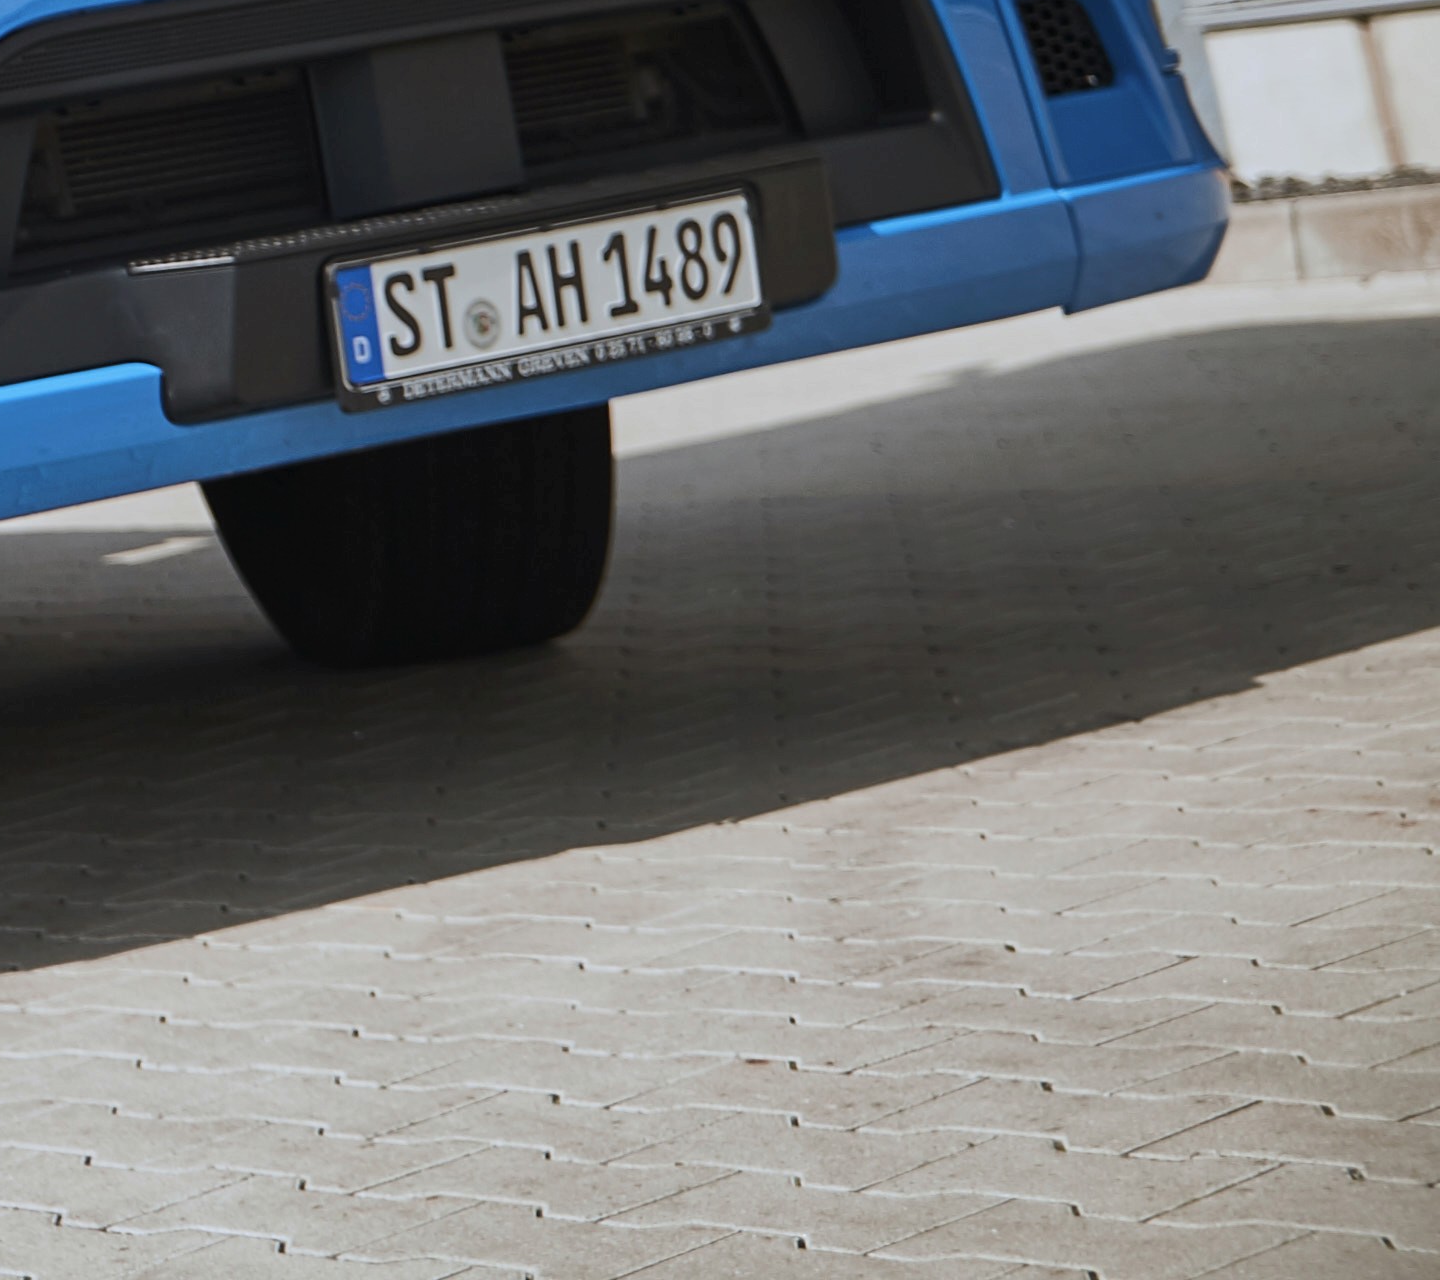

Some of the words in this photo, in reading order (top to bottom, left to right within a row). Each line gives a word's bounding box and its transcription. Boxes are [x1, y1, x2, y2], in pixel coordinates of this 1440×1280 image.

[384, 262, 456, 357] ST
[516, 240, 589, 336] AH
[602, 212, 741, 318] 1489
[353, 335, 372, 364] D
